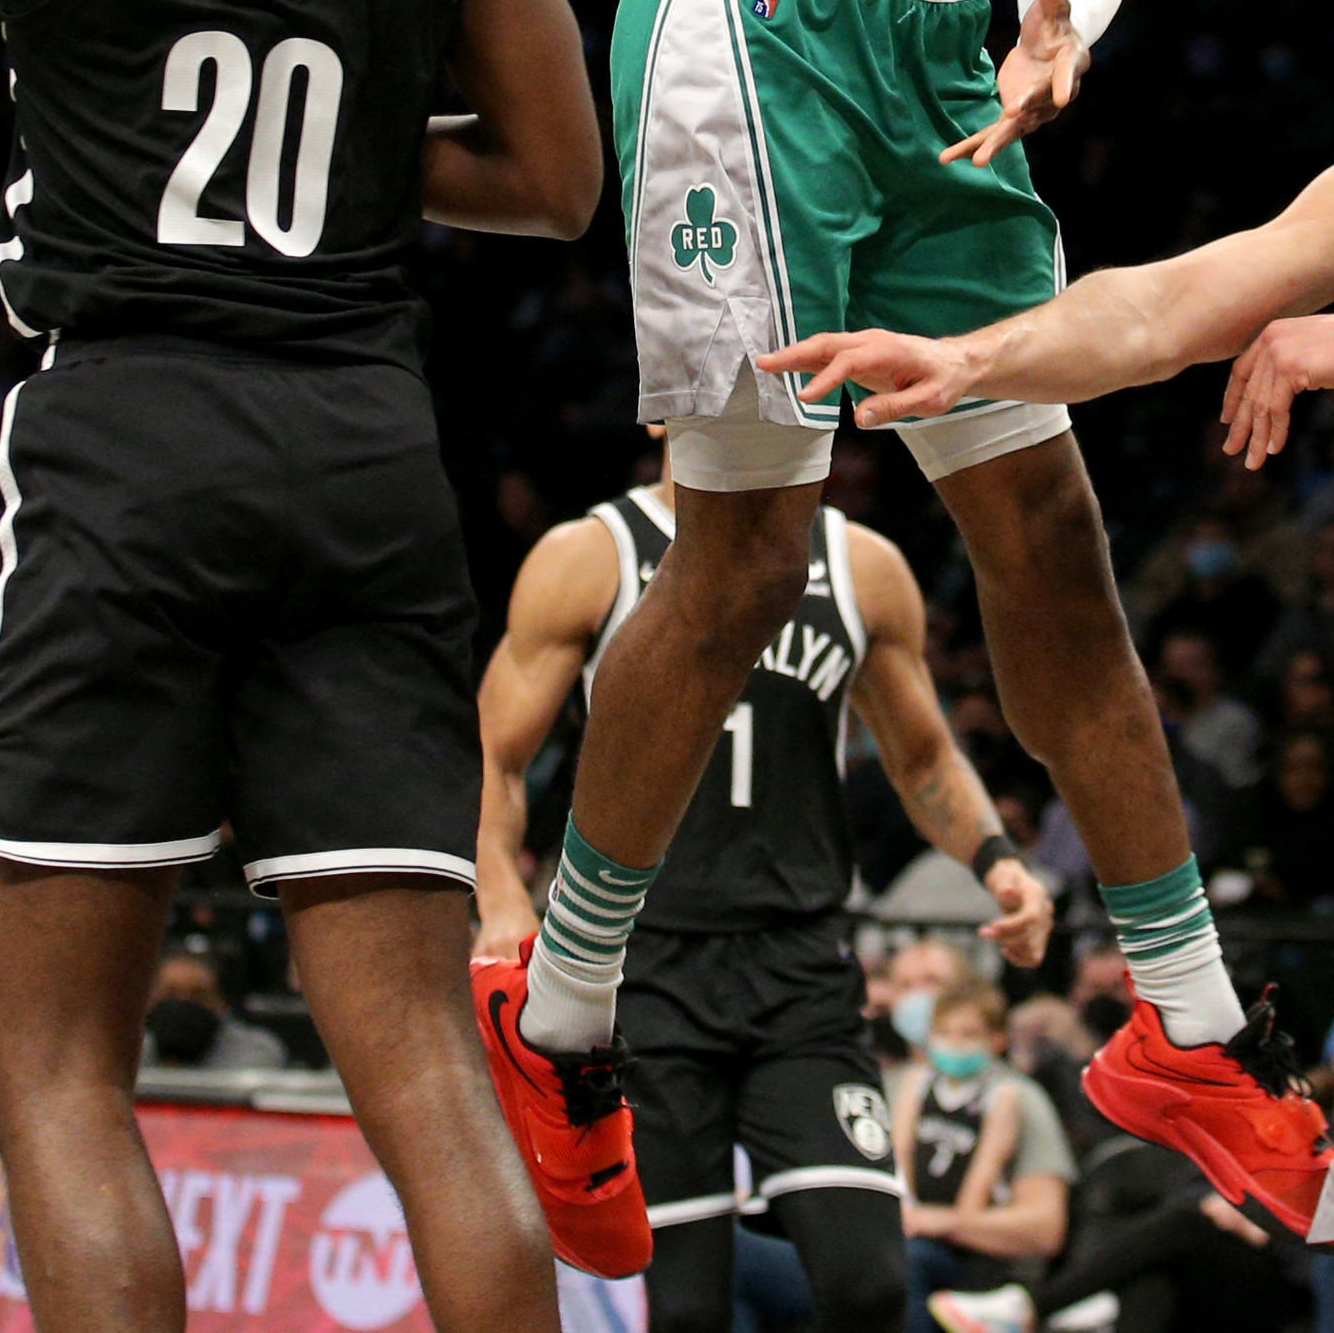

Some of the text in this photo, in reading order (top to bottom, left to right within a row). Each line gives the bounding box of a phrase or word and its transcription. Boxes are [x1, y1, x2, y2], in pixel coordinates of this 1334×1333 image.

[156, 30, 344, 258] 20
[682, 226, 723, 250] RED
[722, 701, 754, 809] 1
